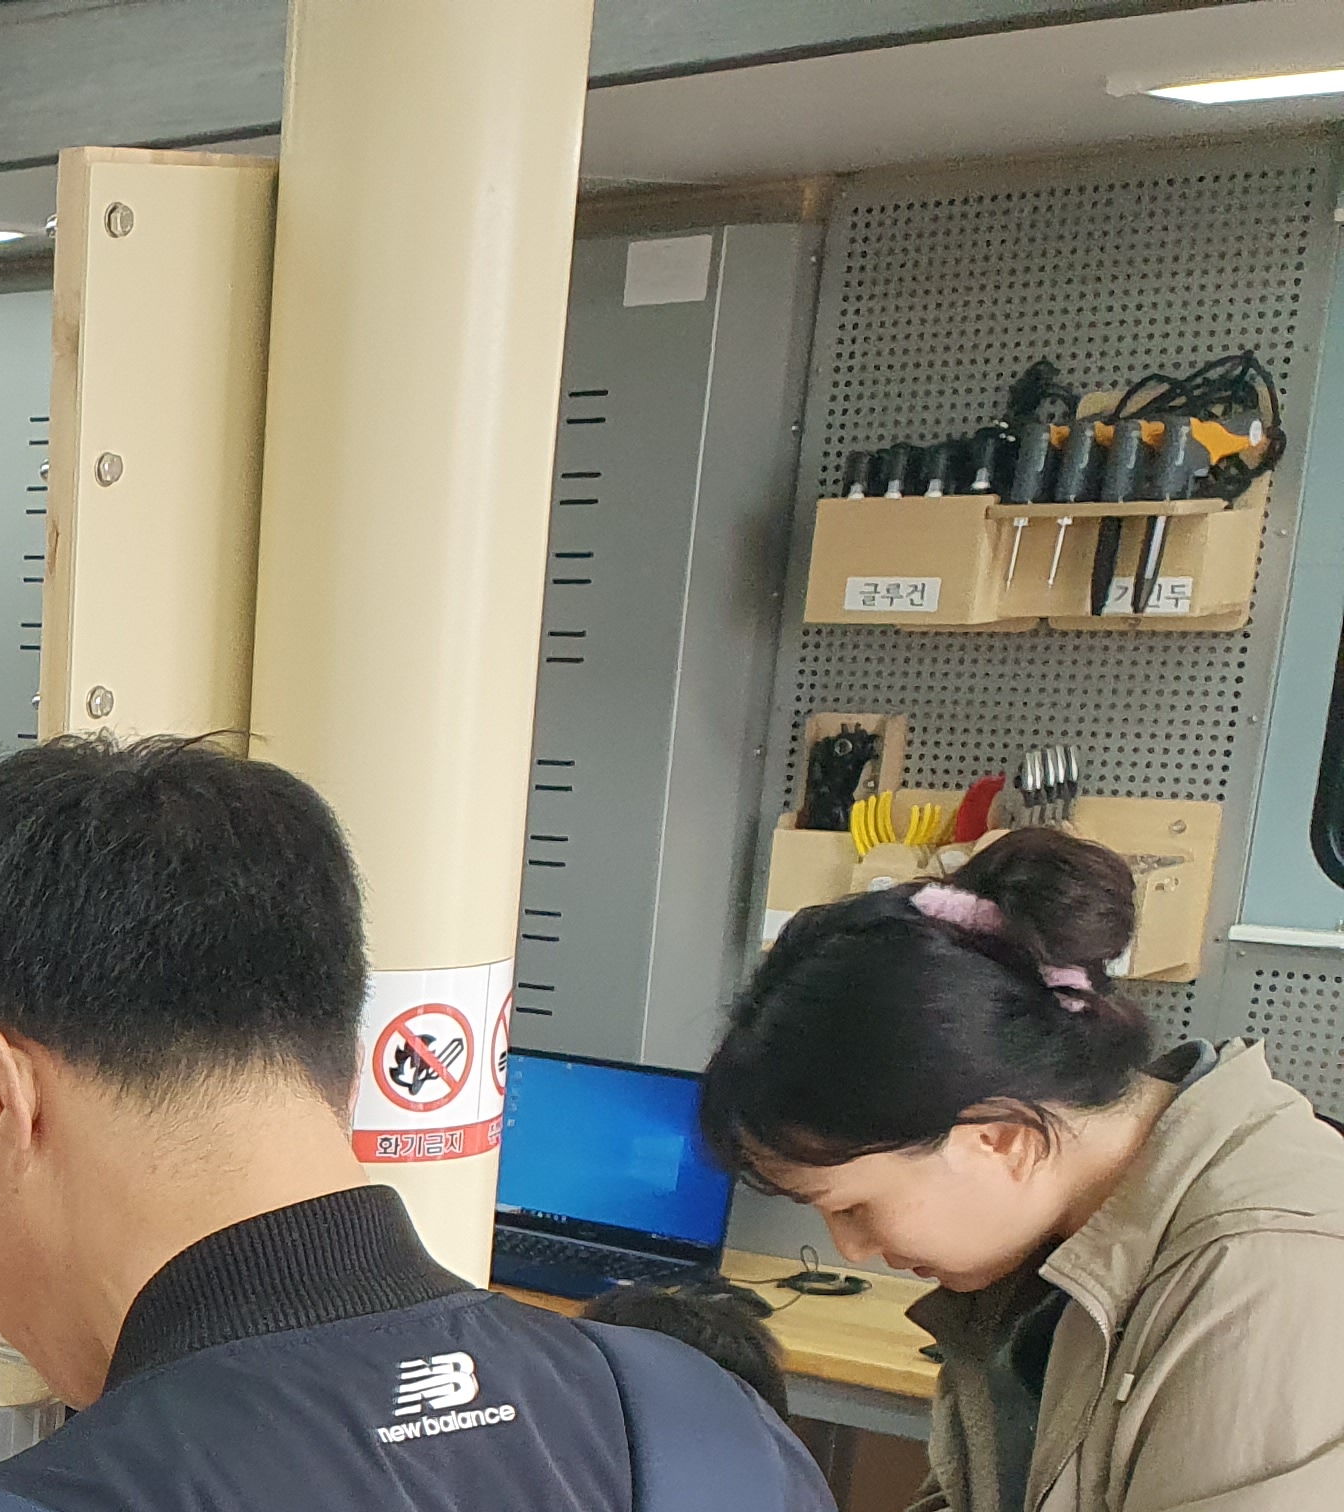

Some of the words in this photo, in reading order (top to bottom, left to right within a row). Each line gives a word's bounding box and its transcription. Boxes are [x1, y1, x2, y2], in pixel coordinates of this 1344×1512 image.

[859, 582, 926, 607] 글루건
[375, 1131, 463, 1157] 화기금지
[377, 1421, 422, 1443] new
[421, 1404, 516, 1436] balance
